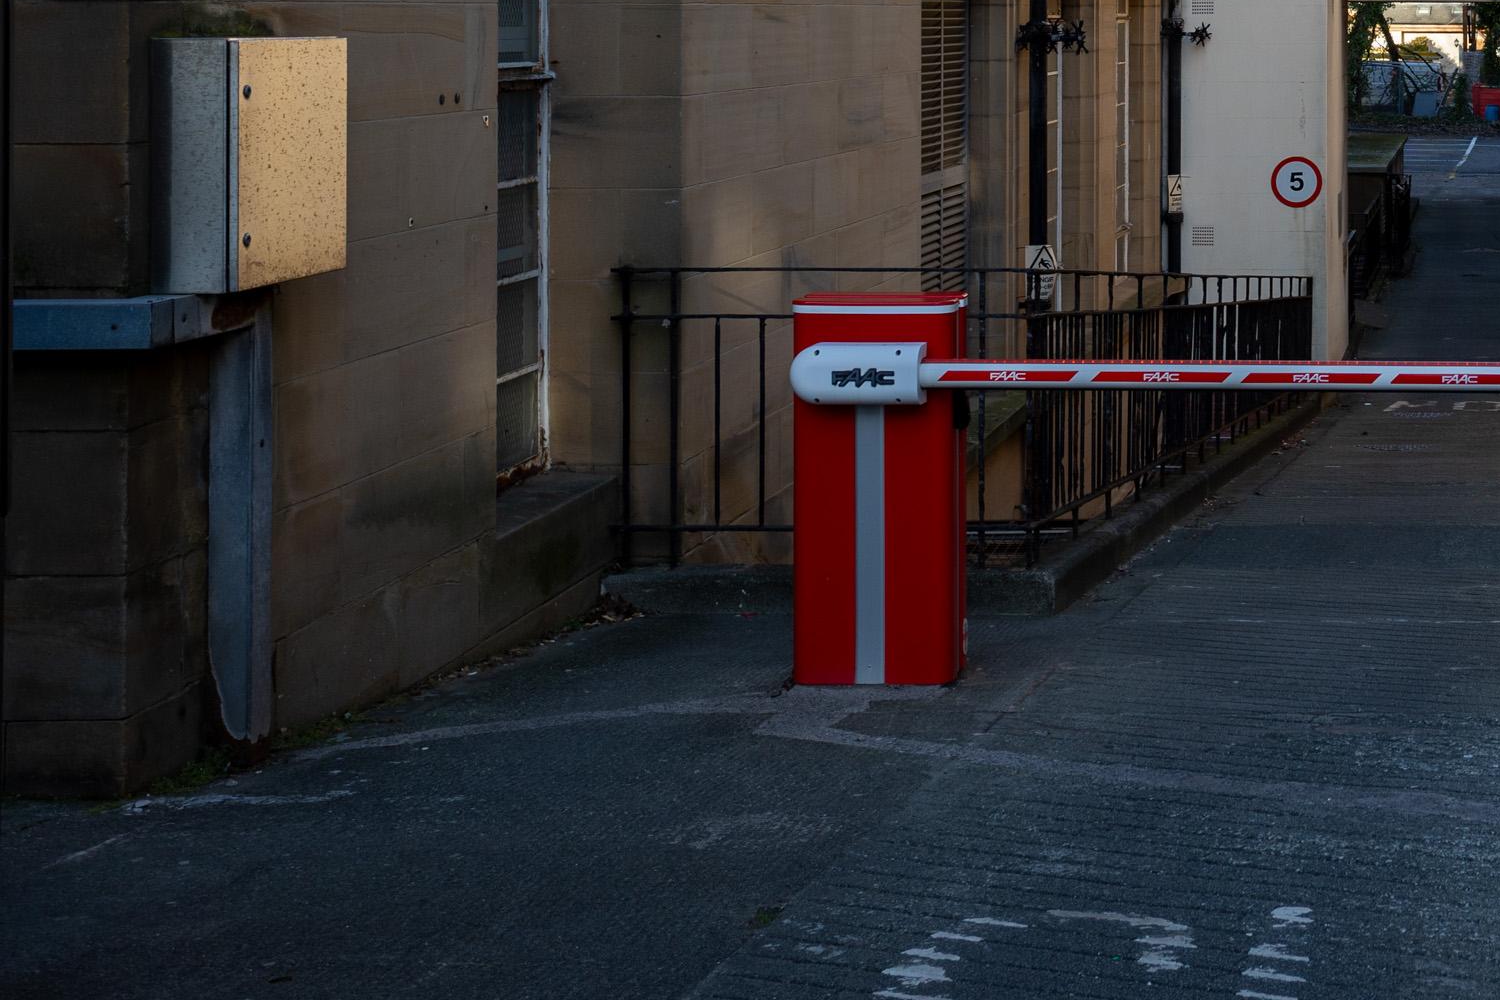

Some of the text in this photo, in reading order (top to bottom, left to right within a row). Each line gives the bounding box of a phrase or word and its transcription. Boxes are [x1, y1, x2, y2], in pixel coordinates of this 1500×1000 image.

[1290, 171, 1305, 192] 5
[832, 368, 895, 389] FAAC
[990, 372, 1026, 380] FAAC
[1144, 373, 1179, 381] FAAC
[1293, 374, 1328, 382] FAAC
[1442, 375, 1478, 383] FAAC
